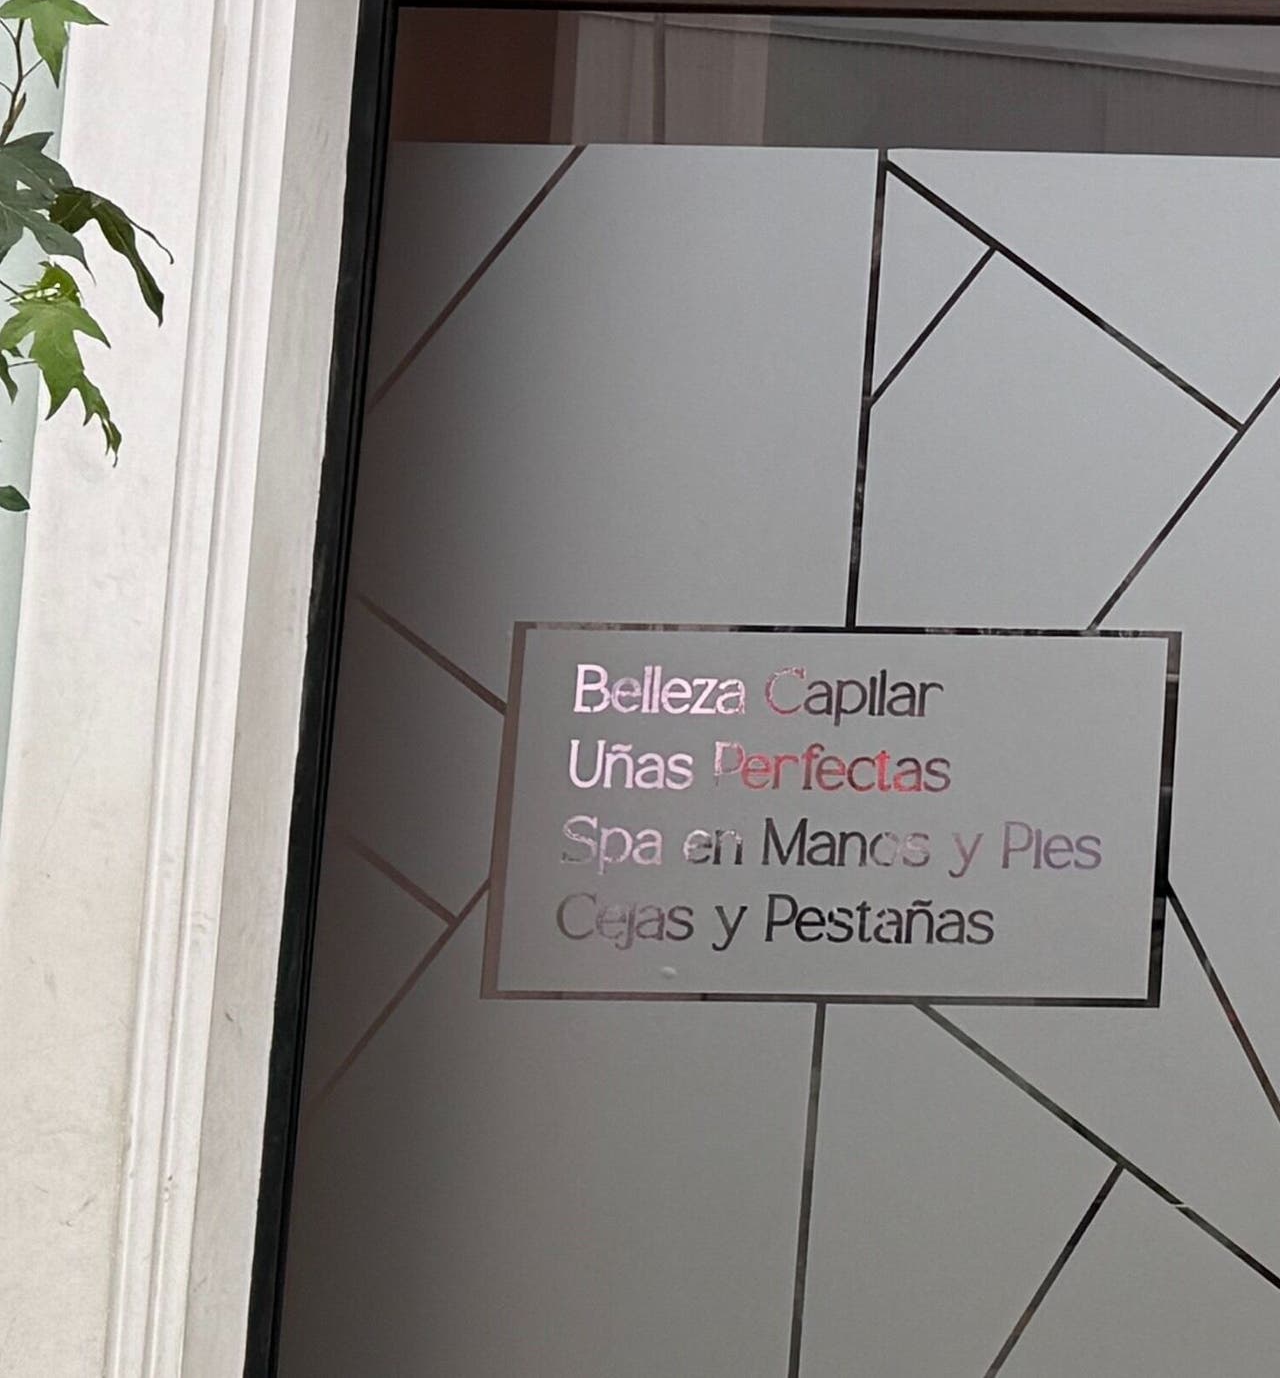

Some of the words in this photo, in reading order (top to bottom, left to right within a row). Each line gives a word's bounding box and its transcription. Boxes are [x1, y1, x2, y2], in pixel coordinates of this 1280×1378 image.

[572, 663, 746, 715] Belleza
[764, 666, 944, 727] Capilar
[568, 739, 694, 790] Uñas
[713, 740, 952, 793] Perfectas
[560, 815, 664, 875] Spa
[682, 827, 744, 866] en
[760, 817, 931, 868] Manos
[947, 831, 985, 879] y
[1001, 821, 1103, 871] Pies
[555, 892, 695, 951] Cejas
[711, 904, 749, 952] y
[764, 893, 996, 945] Pestañas
